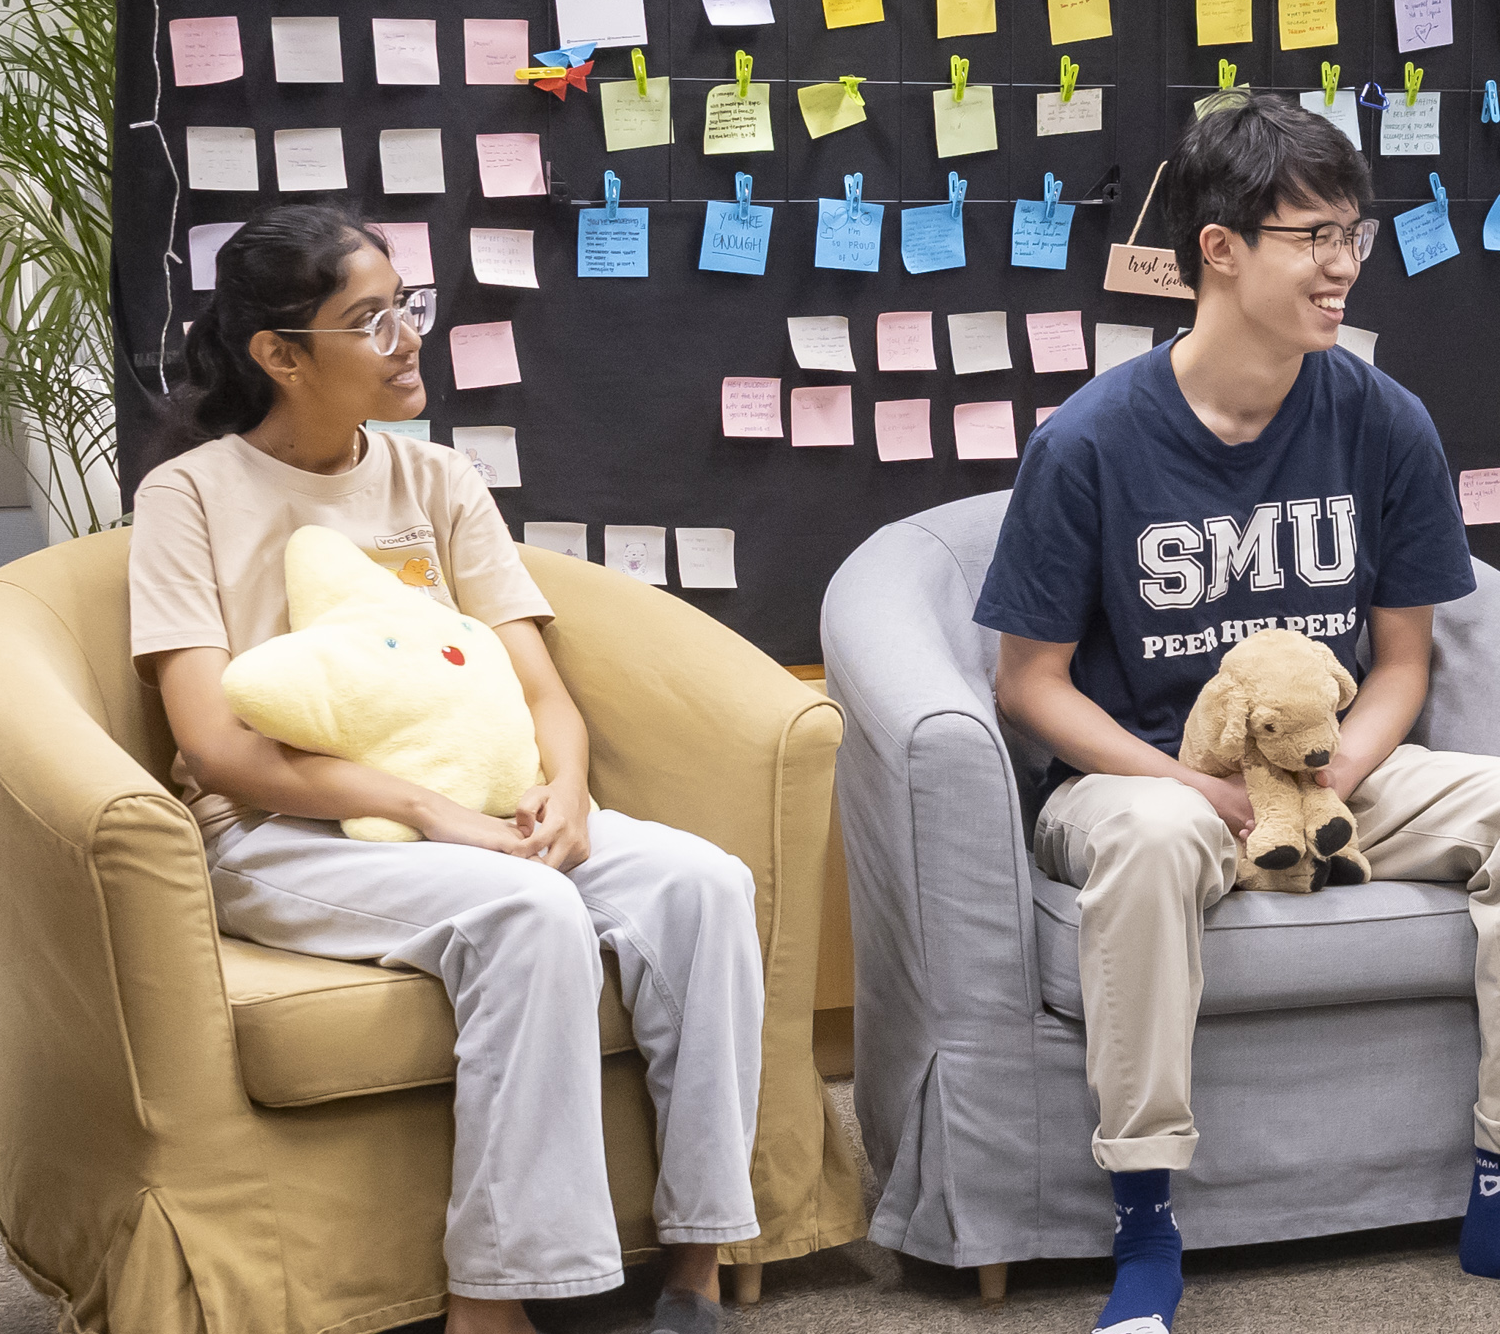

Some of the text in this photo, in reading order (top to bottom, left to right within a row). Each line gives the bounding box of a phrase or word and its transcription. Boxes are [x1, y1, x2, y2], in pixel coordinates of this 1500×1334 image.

[712, 233, 762, 253] ENOUGH
[848, 241, 876, 250] PROUD
[1128, 254, 1159, 275] trust
[380, 529, 435, 545] VOICES@S
[1136, 494, 1357, 611] SMU
[1142, 626, 1219, 659] PEER
